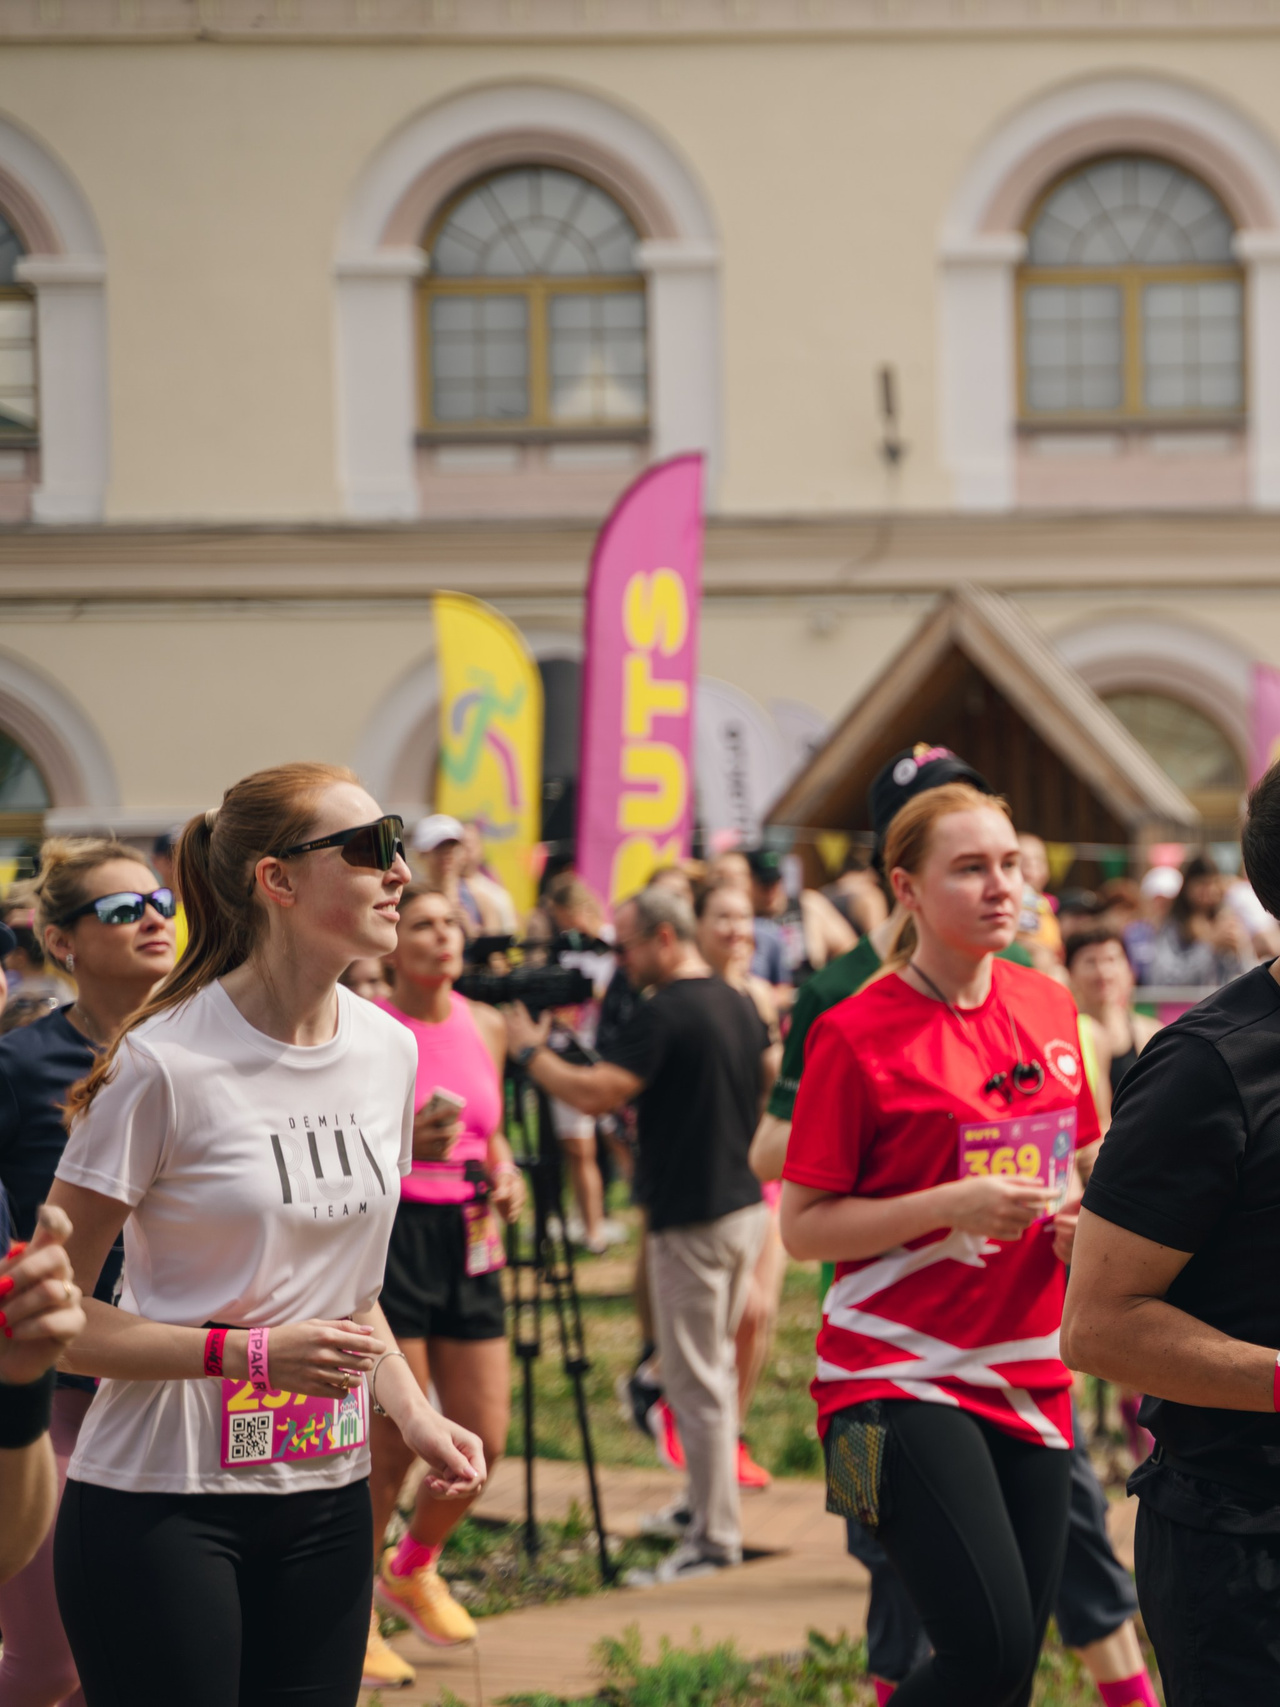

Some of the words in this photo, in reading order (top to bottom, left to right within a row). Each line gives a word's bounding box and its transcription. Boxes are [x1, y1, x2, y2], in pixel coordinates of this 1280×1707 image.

[288, 1113, 357, 1129] DEMIX
[270, 1128, 392, 1204] RUN
[964, 1143, 1041, 1180] 369
[312, 1201, 368, 1219] TEAM
